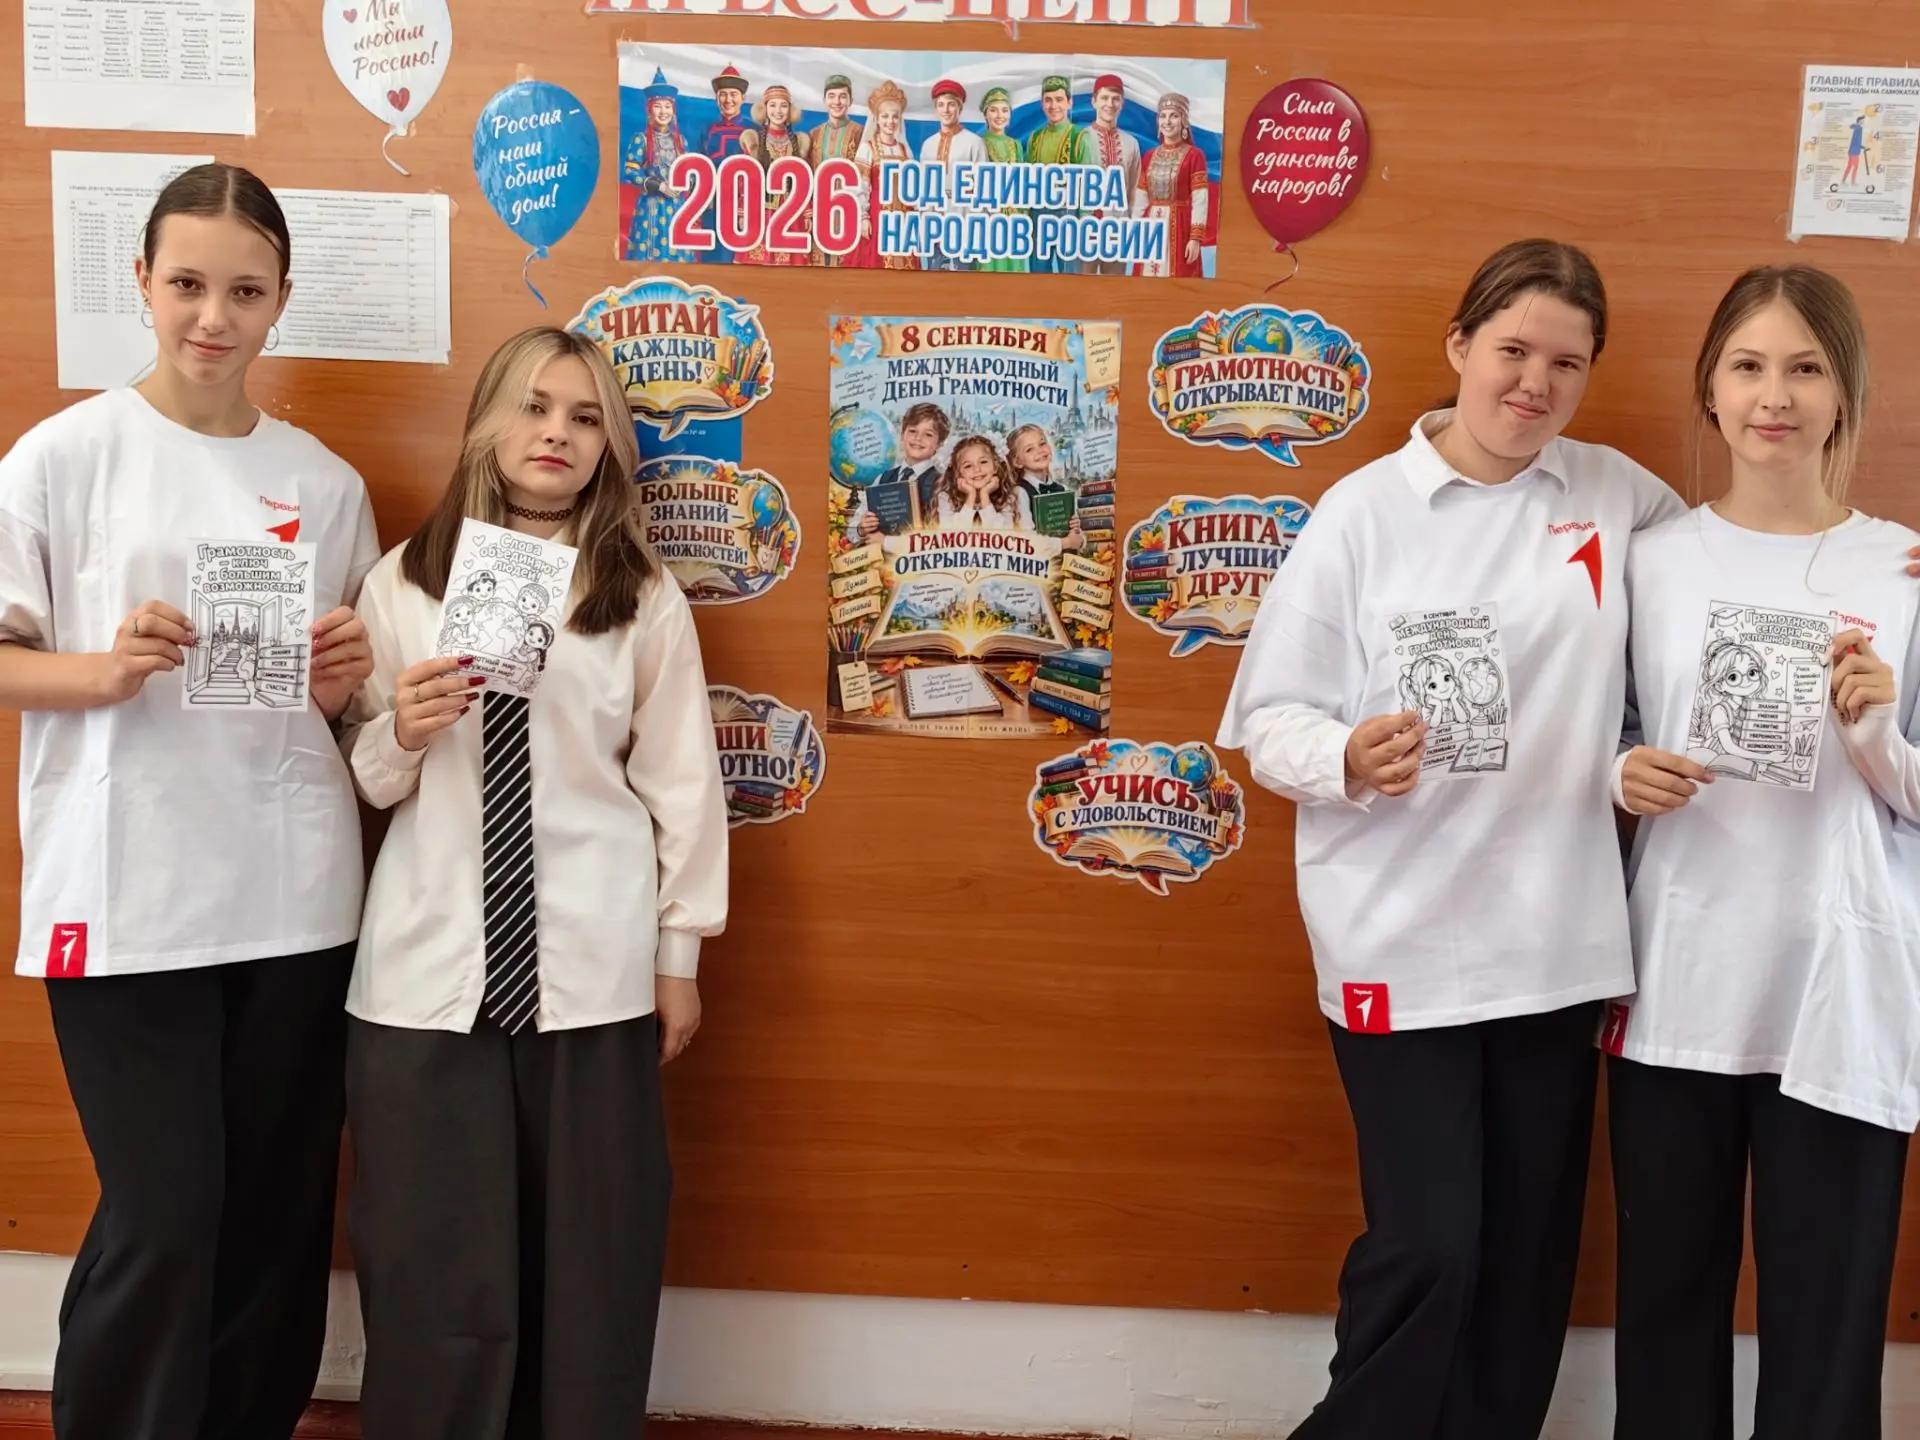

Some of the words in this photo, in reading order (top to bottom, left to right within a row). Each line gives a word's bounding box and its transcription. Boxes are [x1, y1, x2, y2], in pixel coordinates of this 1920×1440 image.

[354, 21, 424, 51] любим
[353, 40, 438, 79] Россию!
[1810, 76, 1864, 86] ГЛАВНЫЕ
[1866, 77, 1920, 88] ПРАВИЛА
[1283, 92, 1335, 115] Сила
[492, 109, 561, 139] Россия
[1257, 118, 1332, 141] России
[1338, 118, 1351, 142] в
[499, 141, 542, 164] наш
[1253, 145, 1358, 175] единстве
[505, 156, 568, 189] общий
[882, 163, 945, 206] ГОД
[960, 164, 1125, 210] ЕДИНСТВА
[1252, 172, 1352, 204] народов!
[511, 183, 559, 225] дом!
[671, 157, 859, 251] 2026
[881, 214, 1032, 259] НАРОДОВ
[1039, 218, 1164, 261] РОССИИ
[600, 297, 720, 341] ЧИТАЙ
[613, 337, 716, 366] КАЖДЫЙ
[900, 325, 920, 353] 8
[926, 325, 1049, 354] СЕНТЯБРЯ
[625, 361, 702, 391] ДЕНЬ!
[888, 357, 1060, 383] МЕЖДУНАРОДНЫЙ
[1173, 358, 1345, 393] ГРАМОТНОСТЬ
[882, 379, 933, 405] ДЕНЬ
[939, 377, 1069, 407] ГРАМОТНОСТИ
[1174, 383, 1293, 412] ОТКРЫВАЕТ
[1297, 386, 1346, 417] МИР!
[641, 483, 739, 506] БОЛЬШЕ
[650, 504, 729, 523] ЗНАНИЙ
[501, 533, 543, 556] Слова
[647, 524, 735, 547] БОЛЬШЕ
[908, 531, 1036, 556] ГРАМОТНОСТЬ
[1167, 513, 1281, 550] КНИГА
[198, 544, 296, 562] Грамотность
[232, 558, 269, 568] ключ
[479, 543, 559, 577] объединяют
[653, 543, 748, 566] ЗМОЖНОСТЕЙ!
[895, 550, 1004, 575] ОТКРЫВАЕТ
[1007, 554, 1049, 579] МИР!
[208, 570, 217, 581] к
[220, 567, 282, 581] большим
[492, 560, 541, 583] людей!
[203, 580, 306, 595] возможностям!
[1395, 615, 1490, 641] МЕЖДУНАРОДНЫЙ
[1745, 609, 1829, 633] Грамотность
[1756, 625, 1802, 638] сегодня
[1408, 637, 1482, 656] ГРАМОТНОСТИ
[1739, 633, 1790, 647] успешное
[720, 753, 796, 785] ОТНО!
[1078, 774, 1198, 812] УЧИСЬ
[1055, 811, 1066, 828] С
[1072, 805, 1218, 838] УДОВОЛЬСТВИЕМ!
